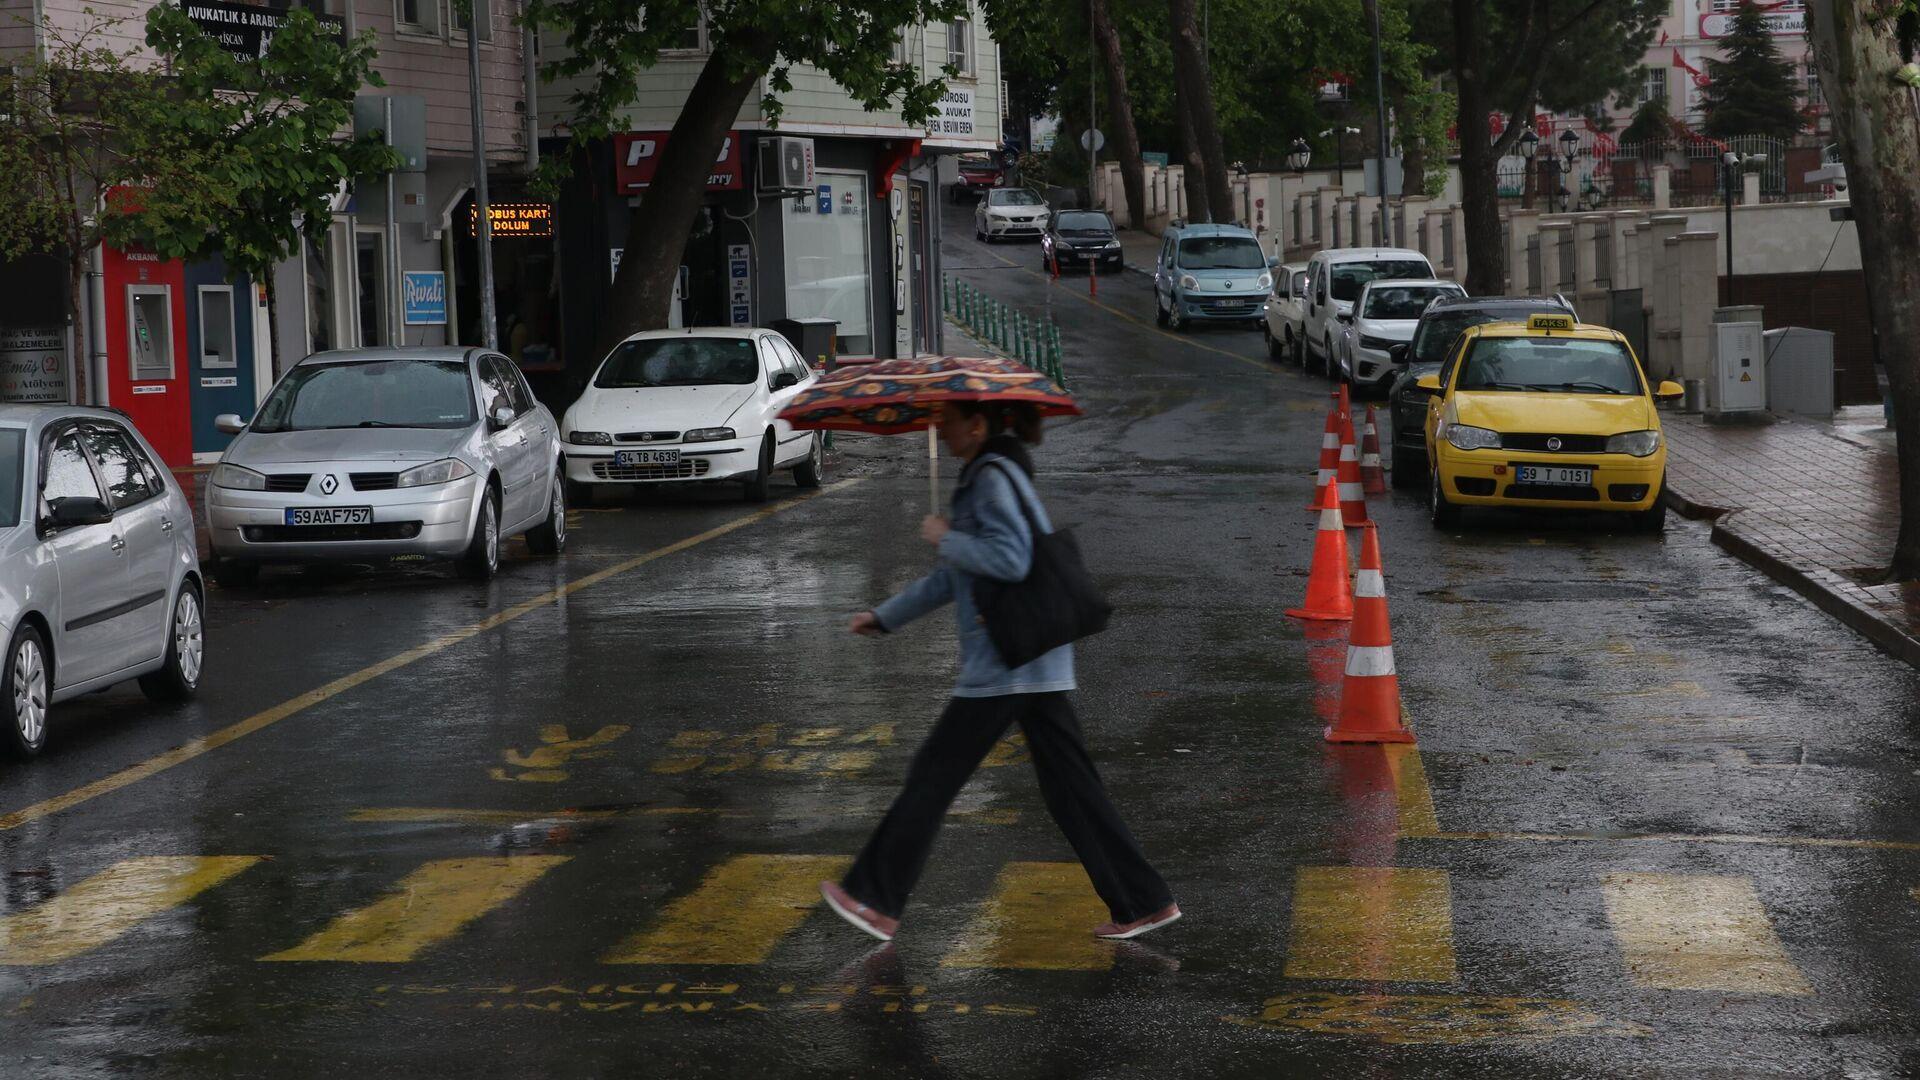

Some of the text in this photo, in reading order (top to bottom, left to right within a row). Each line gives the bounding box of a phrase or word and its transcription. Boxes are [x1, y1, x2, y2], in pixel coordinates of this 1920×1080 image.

[187, 6, 239, 24] AVUKATLIK
[241, 13, 248, 23] &
[945, 107, 971, 118] AVUKAT
[960, 121, 972, 134] EREN
[518, 209, 547, 219] KART
[494, 221, 529, 230] DOLUM
[127, 253, 160, 261] AKBANK
[621, 450, 677, 463] 34 TB 4639
[1522, 467, 1589, 482] 59 T 0151
